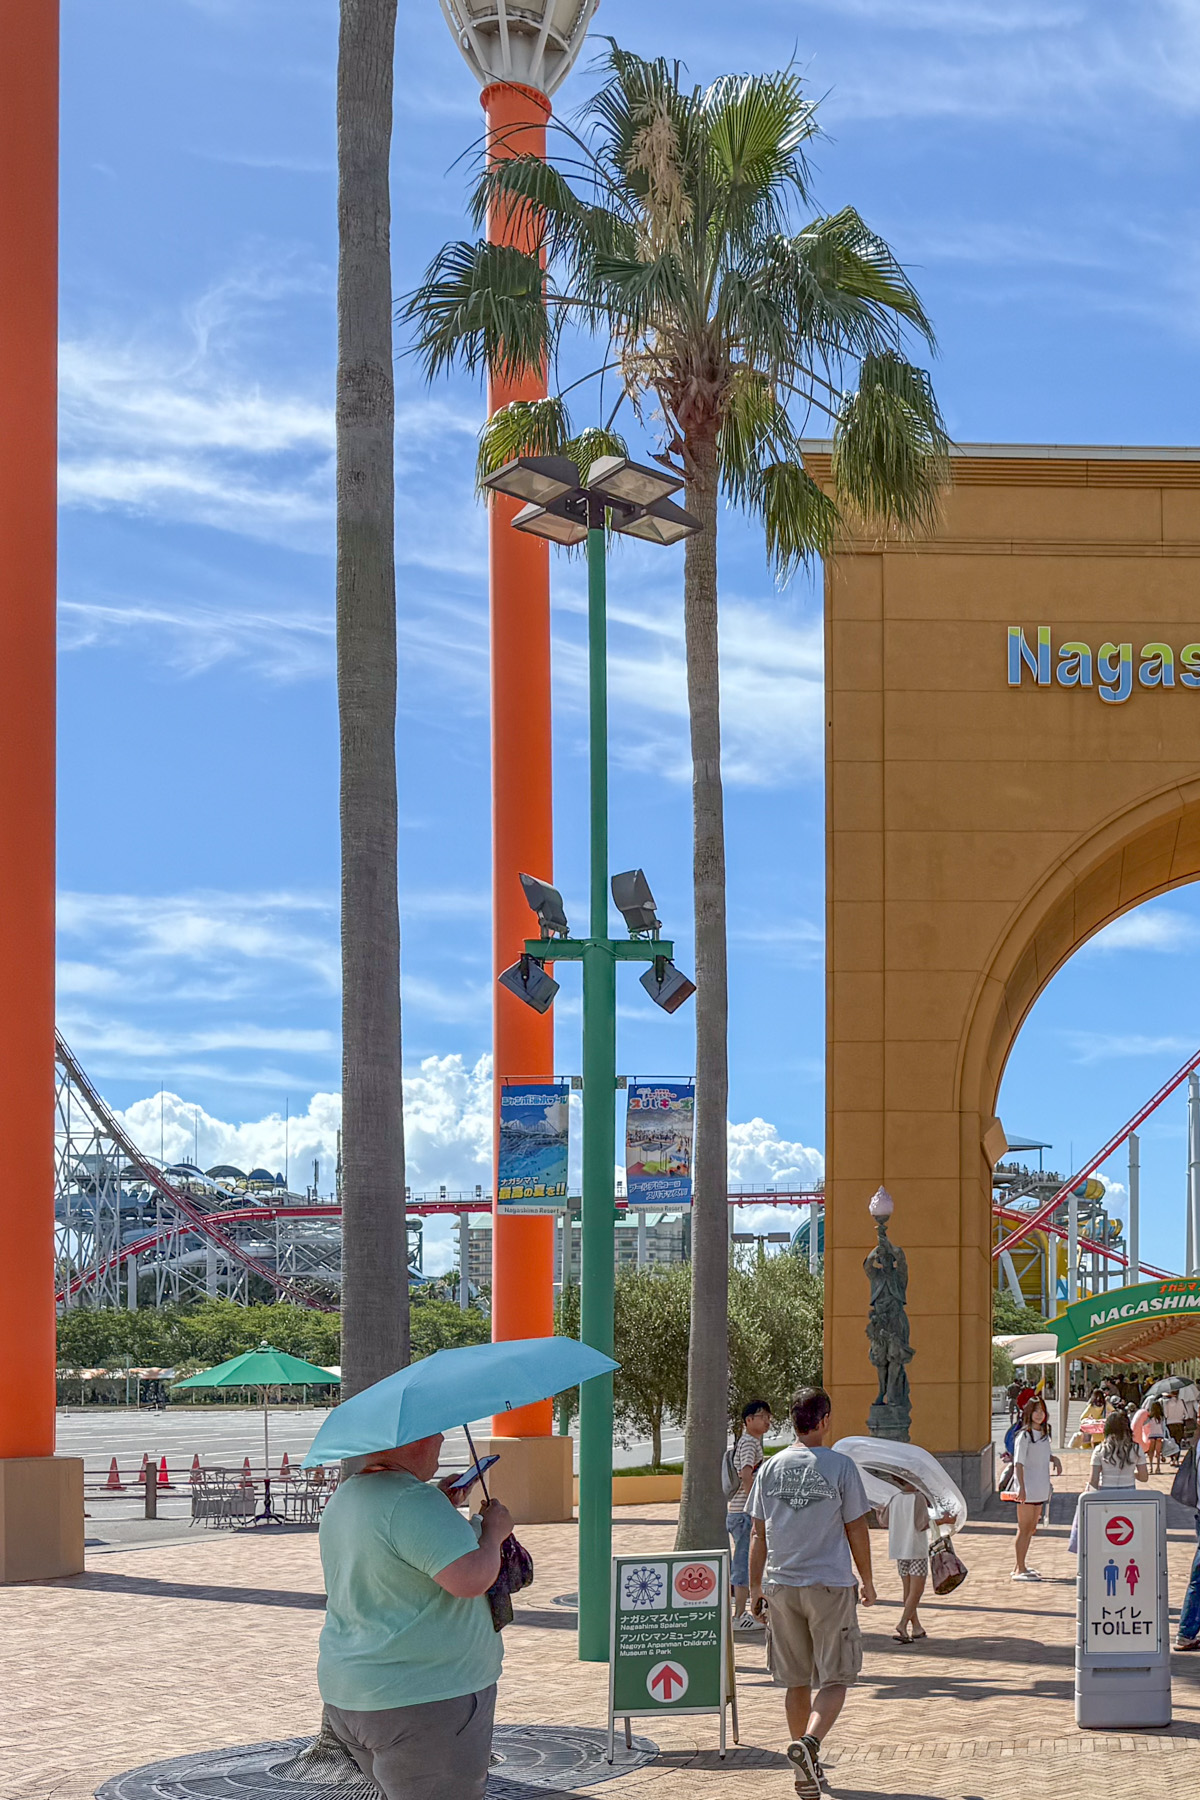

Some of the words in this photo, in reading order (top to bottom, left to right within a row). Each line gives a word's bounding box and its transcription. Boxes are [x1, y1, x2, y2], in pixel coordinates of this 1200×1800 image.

[620, 1611, 716, 1624] ナガシマスパーランド
[1102, 1606, 1141, 1619] トイレ
[620, 1623, 658, 1631] Nagashima
[660, 1621, 688, 1630] Spaland
[1091, 1621, 1153, 1635] TOILET
[620, 1630, 717, 1642] アンパンマンミュージアム
[647, 1641, 682, 1649] Anpanman
[683, 1639, 717, 1647] Children's
